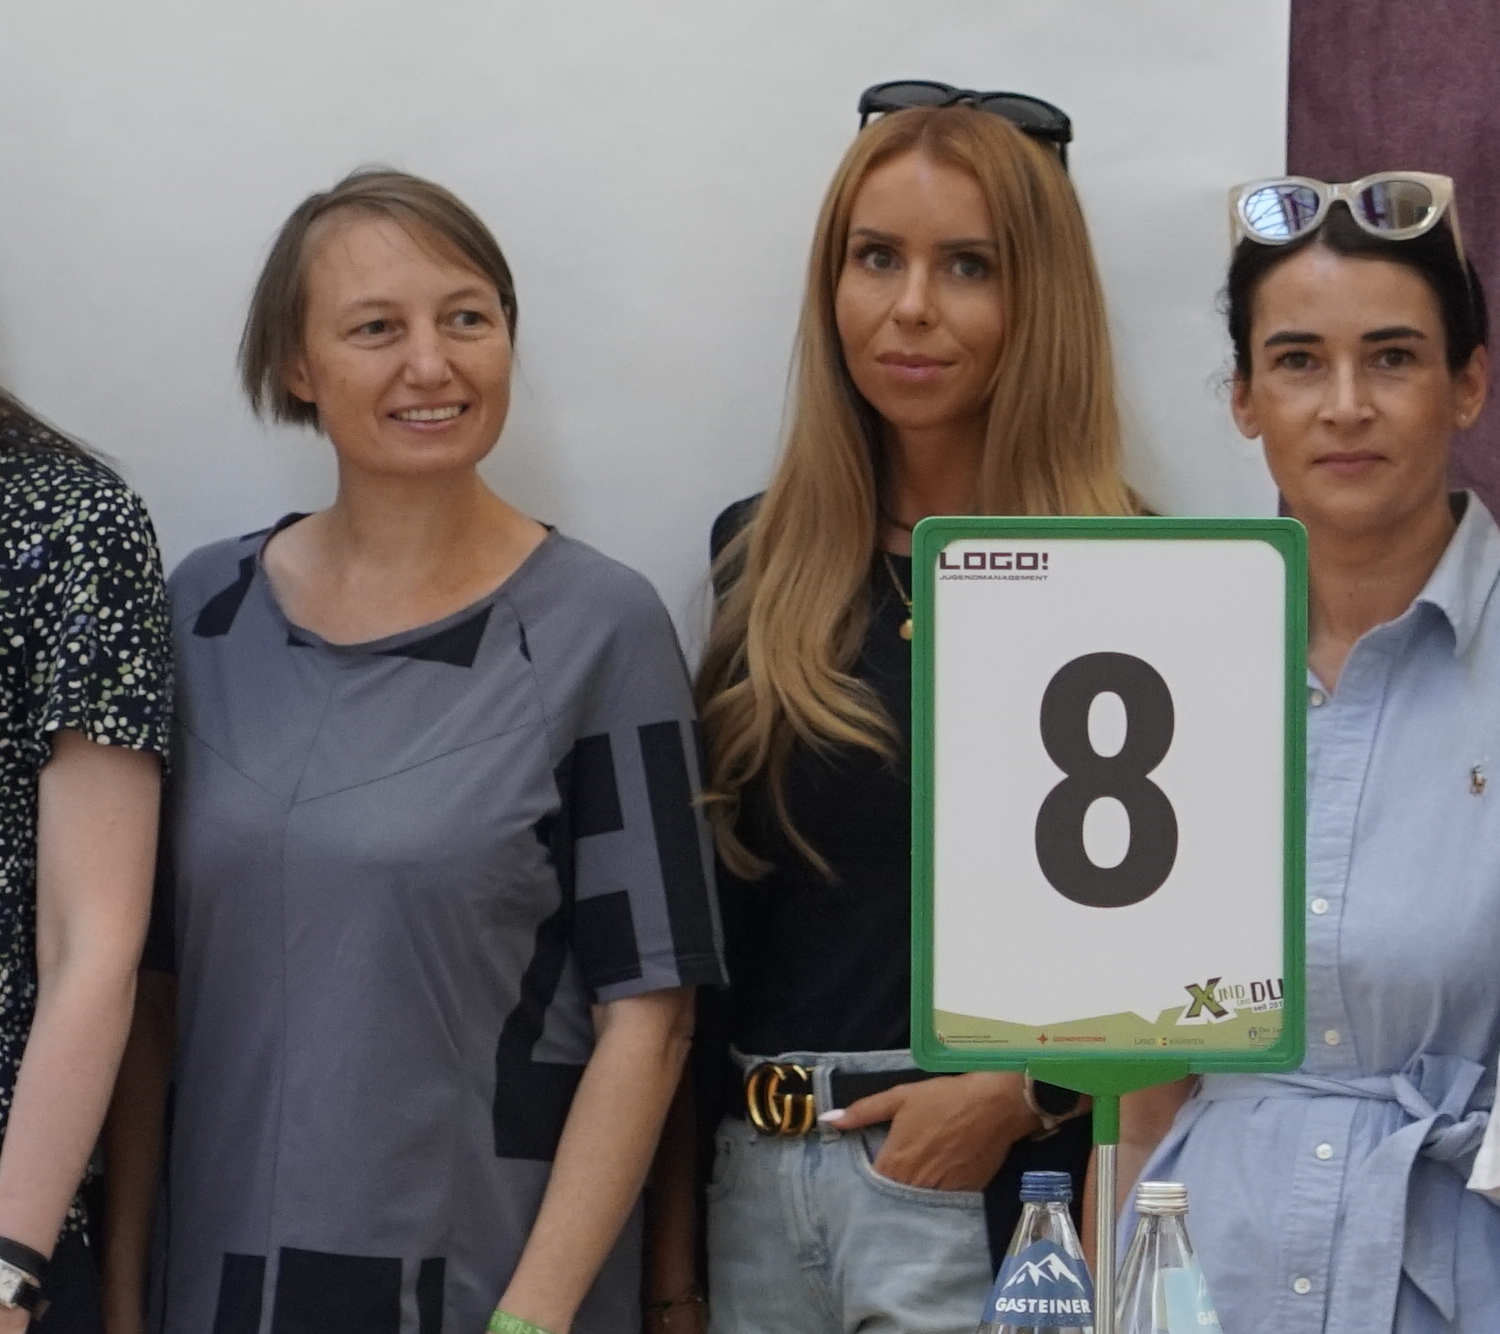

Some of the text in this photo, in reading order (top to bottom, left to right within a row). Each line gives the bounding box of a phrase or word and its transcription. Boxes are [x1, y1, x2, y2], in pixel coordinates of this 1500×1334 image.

[940, 552, 1049, 570] LOGO!
[1035, 651, 1178, 908] 8
[995, 1296, 1092, 1315] GASTEINER
